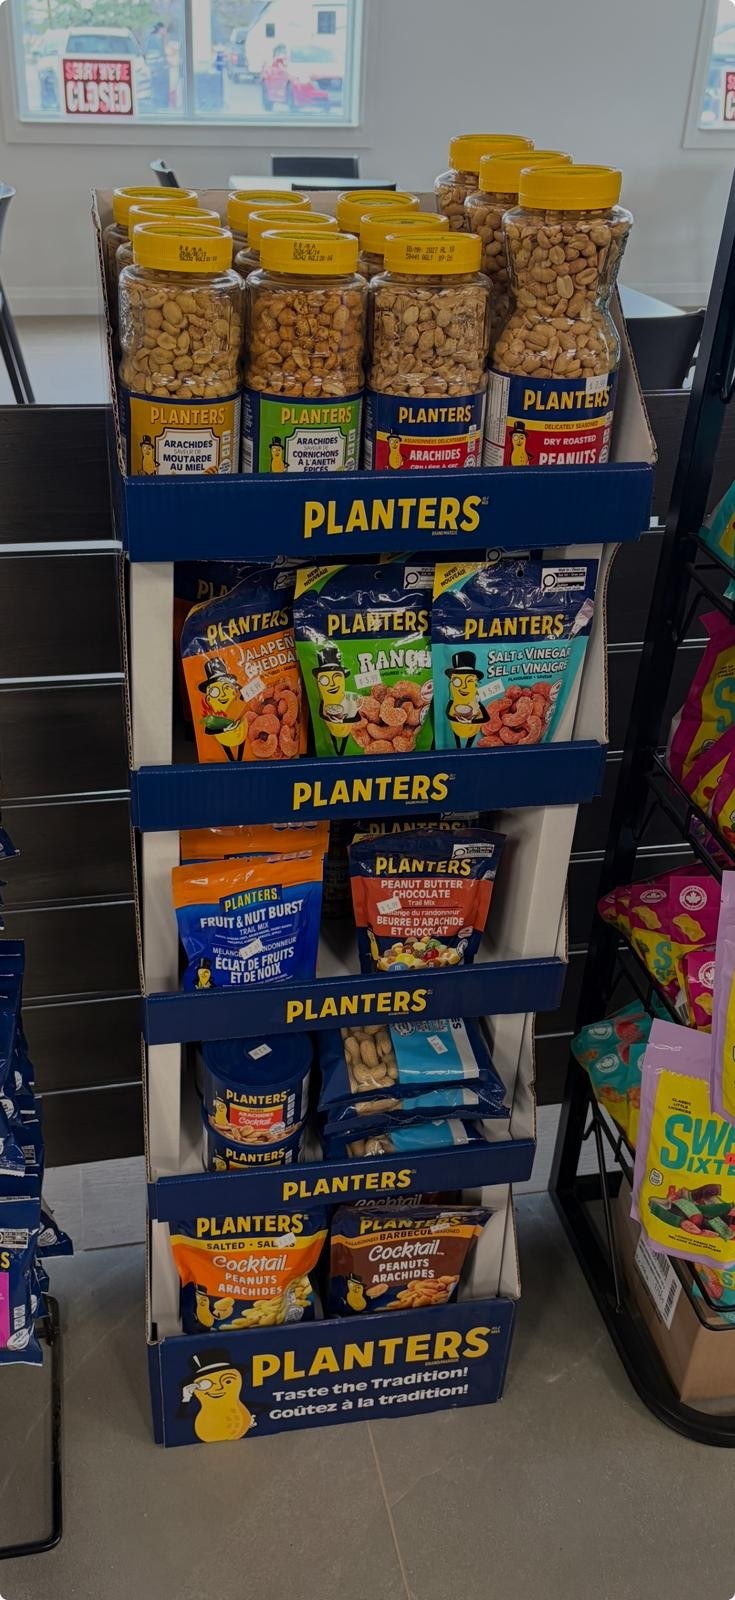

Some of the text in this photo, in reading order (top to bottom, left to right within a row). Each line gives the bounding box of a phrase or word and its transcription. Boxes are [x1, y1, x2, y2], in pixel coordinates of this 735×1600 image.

[66, 81, 132, 113] CLOSED
[523, 387, 610, 411] PLANTERS
[150, 406, 226, 425] PLANTERS
[281, 406, 353, 425] PLANTERS
[398, 405, 473, 424] PLANTERS
[544, 423, 574, 431] DELICATELY
[163, 440, 213, 449] ARACHIDES
[297, 437, 338, 445] ARACHIDES
[543, 435, 597, 446] DRY ROASTED
[163, 454, 212, 463] MOUTARDE
[293, 450, 339, 458] CORNICHONS
[306, 458, 336, 466] L'ANETH
[409, 448, 461, 461] ARACHIDES
[539, 449, 597, 466] PEANUTS
[170, 463, 205, 471] AU MIEL
[303, 495, 482, 539] PLANTERS
[206, 606, 289, 647] PLANTERS
[327, 609, 429, 637] PLANTERS
[464, 613, 566, 641] PLANTERS
[238, 633, 295, 666] JALAPEÑ
[487, 649, 516, 665] SALT
[517, 653, 524, 662] &
[244, 651, 297, 679] CHEDDA
[357, 649, 432, 675] RANCH
[486, 664, 510, 679] SEL
[511, 664, 521, 673] ET
[292, 772, 449, 811] PLANTERS
[375, 855, 473, 876] PLANTERS
[381, 879, 463, 889] PEANUT BUTTER
[224, 887, 279, 913] PLANTERS
[392, 889, 451, 899] CHOCOLATE
[200, 900, 304, 929] FRUIT & NUT BURST
[377, 916, 465, 927] BEURRE D'ARACHIDE
[382, 908, 461, 917] lange du randonneur
[240, 926, 256, 936] TRAIL
[257, 921, 270, 931] MIX
[391, 926, 449, 937] ET CHOCOLAT
[215, 953, 246, 972] ÉCLAT
[247, 956, 260, 971] DE
[261, 946, 295, 967] FRUITS
[230, 971, 243, 984] ET
[243, 970, 256, 983] DE
[257, 962, 282, 981] NOIX
[285, 988, 428, 1024] PLANTERS
[226, 1089, 288, 1105] PLANTERS
[225, 1147, 286, 1163] PLANTERS
[282, 1169, 412, 1201] PLANTERS
[196, 1213, 305, 1238] PLANTERS
[359, 1216, 463, 1235] PLANTERS
[206, 1241, 246, 1250] SALTED
[257, 1239, 296, 1249] SALS
[379, 1230, 433, 1241] BARBECUE
[368, 1239, 441, 1262] Cocktail
[212, 1254, 288, 1274] Cocktail
[378, 1258, 430, 1273] PEANUTS
[225, 1272, 278, 1284] PEANUTS
[371, 1269, 436, 1284] ARACHIDES
[217, 1283, 283, 1296] ARACHIDES
[251, 1326, 491, 1388] PLANTERS
[272, 1366, 469, 1402] Taste the Tradition!
[269, 1384, 469, 1420] Goûtez à la tradition!
